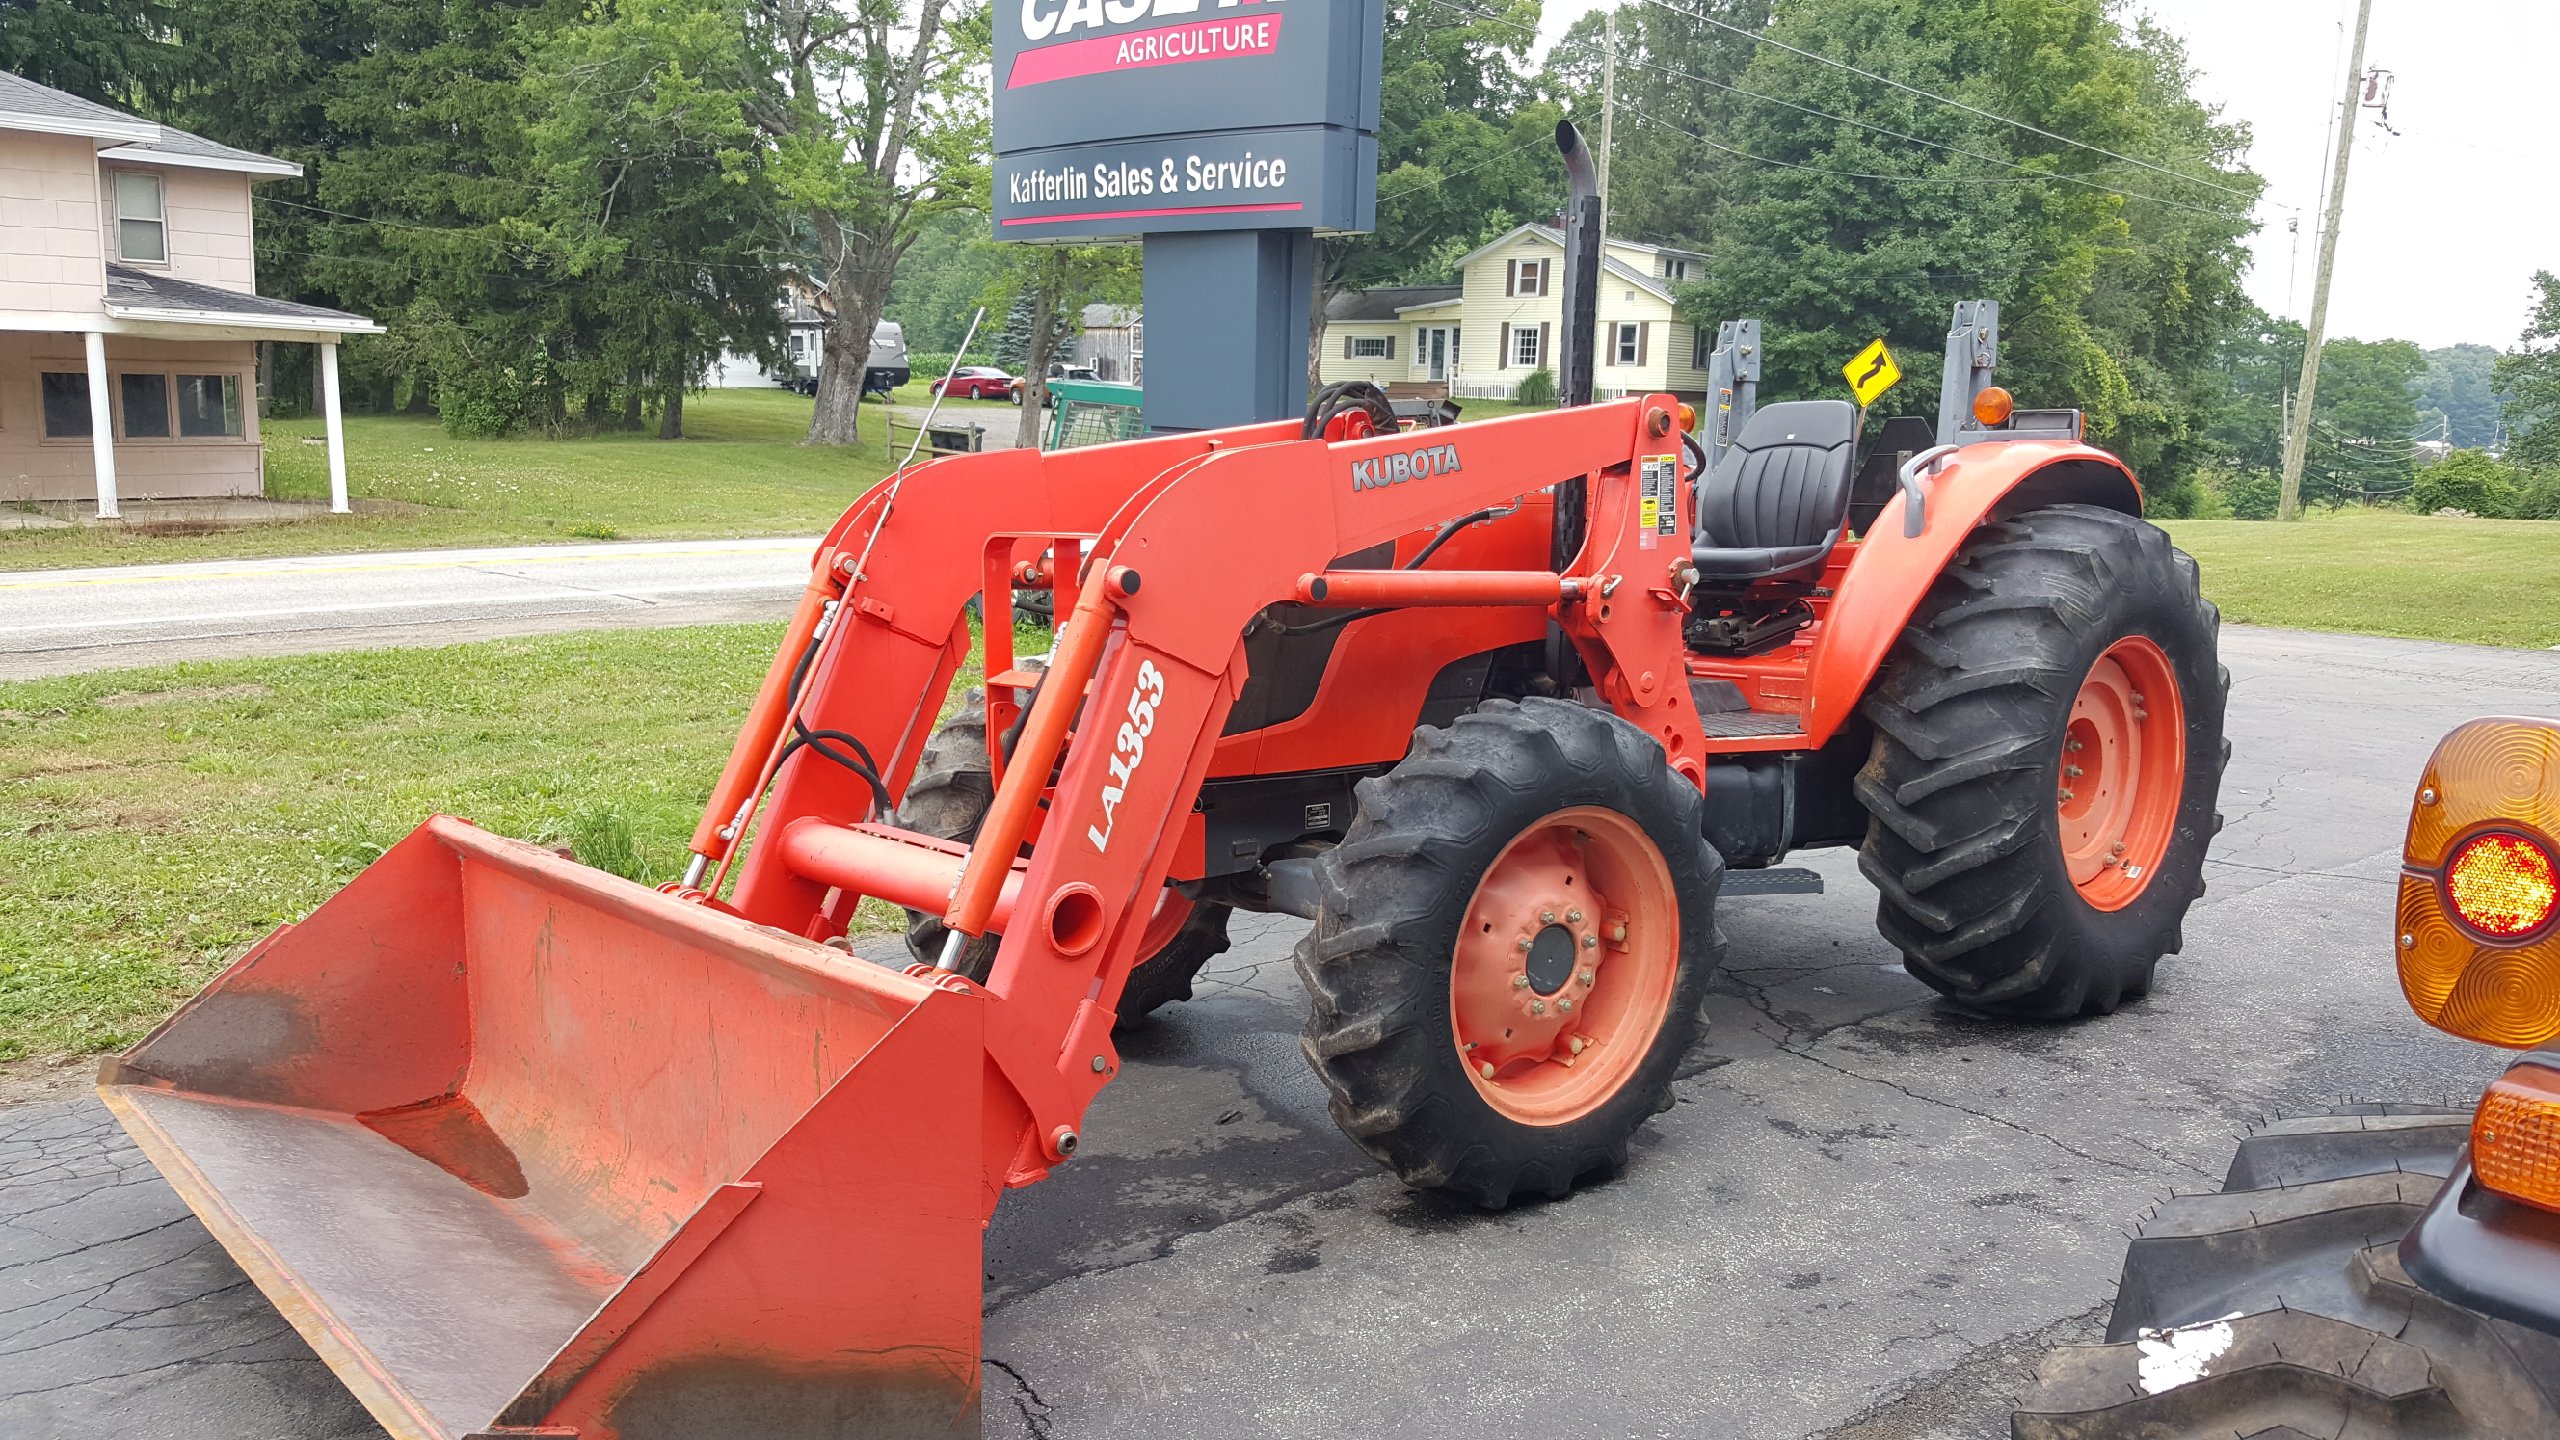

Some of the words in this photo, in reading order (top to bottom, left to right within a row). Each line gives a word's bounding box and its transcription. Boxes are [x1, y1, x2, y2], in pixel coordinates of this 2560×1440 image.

[1115, 22, 1270, 65] AGRICULTURE
[1010, 166, 1088, 204] Kafferlin
[1093, 161, 1154, 199] Sales
[1160, 158, 1179, 194] &
[1186, 151, 1287, 192] Service
[1351, 443, 1463, 493] KUBOTA
[1087, 659, 1165, 854] LA1353
